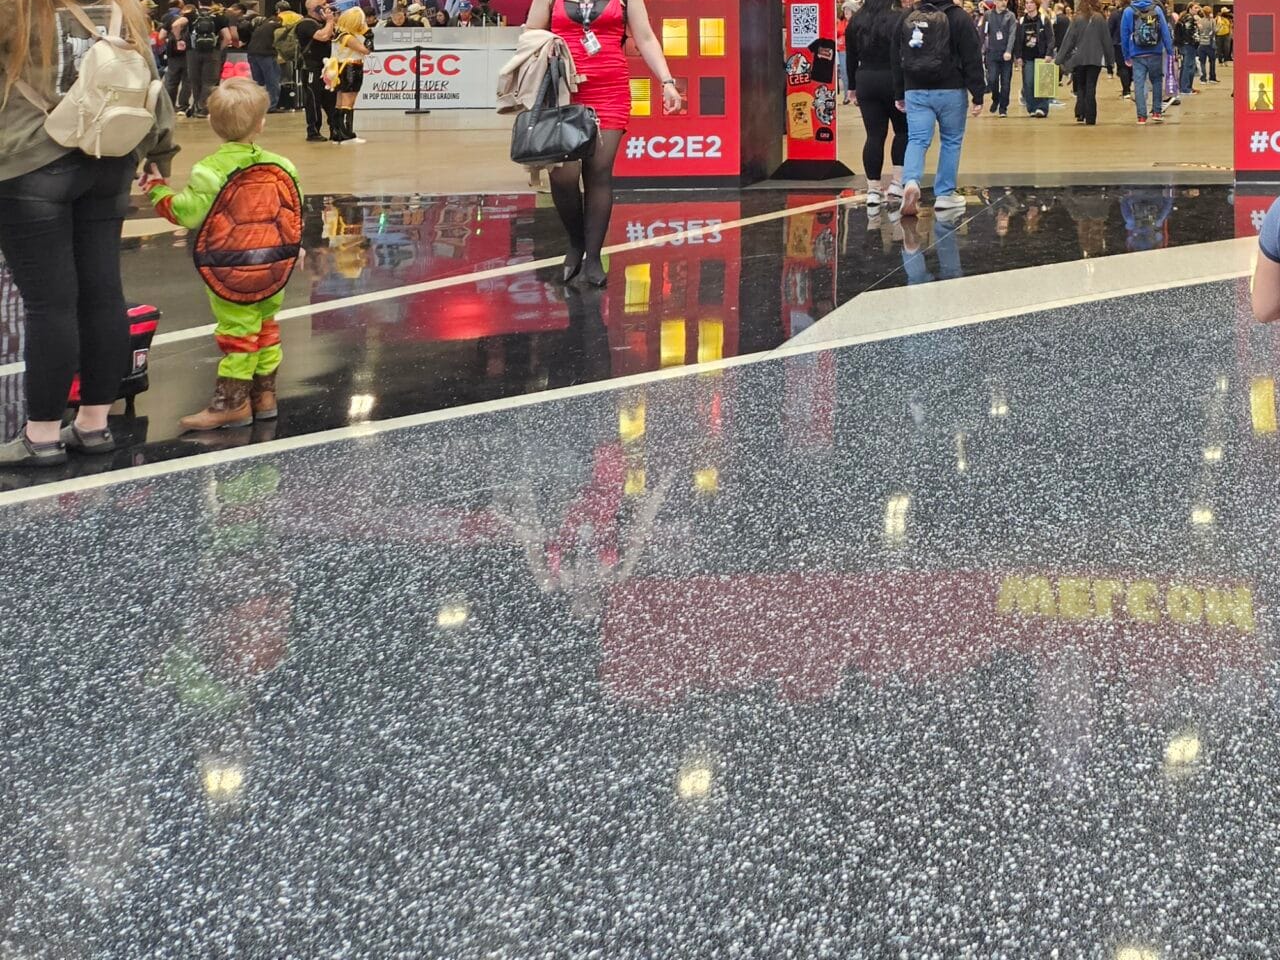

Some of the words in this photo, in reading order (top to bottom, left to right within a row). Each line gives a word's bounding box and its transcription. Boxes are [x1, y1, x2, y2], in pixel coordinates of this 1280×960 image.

[383, 54, 461, 76] CGC
[373, 80, 408, 92] WORLD
[369, 92, 380, 100] POP
[625, 135, 723, 159] #C2E2
